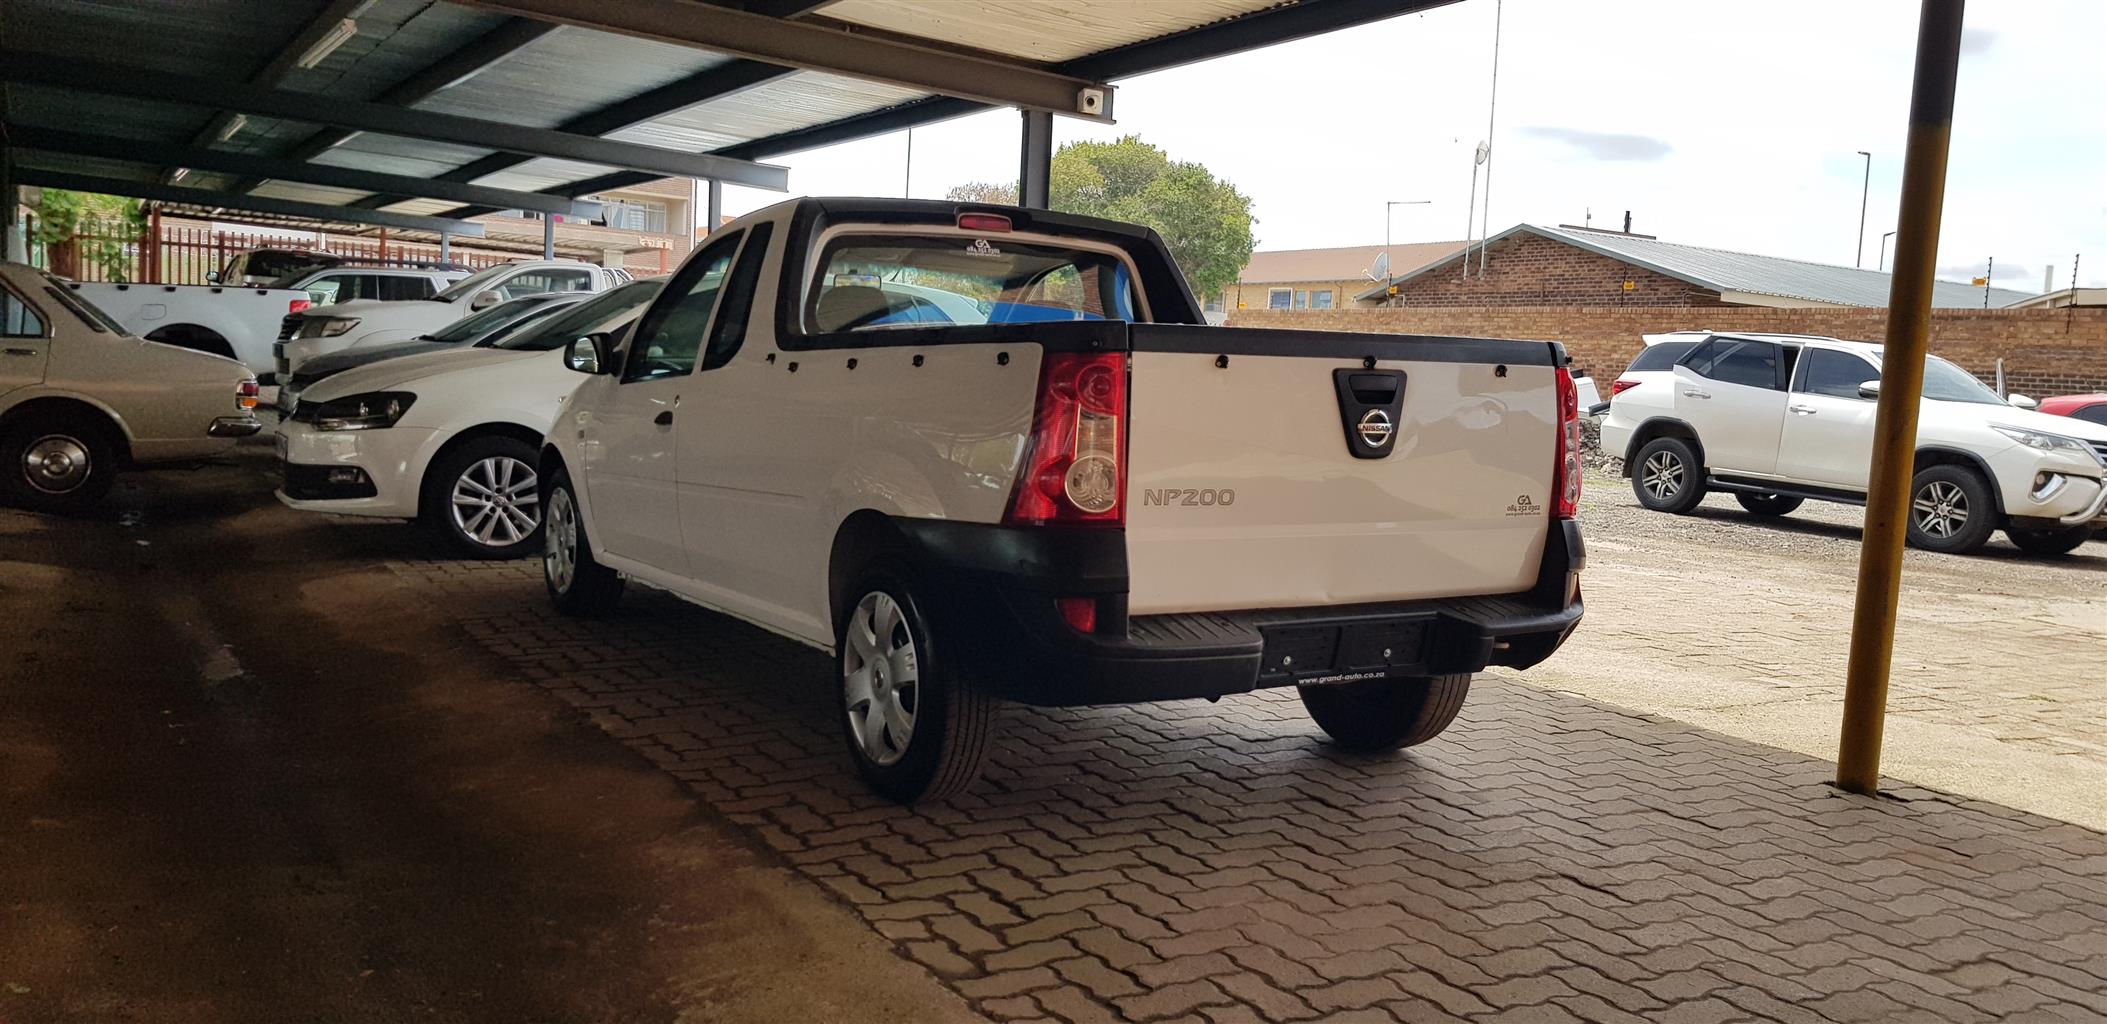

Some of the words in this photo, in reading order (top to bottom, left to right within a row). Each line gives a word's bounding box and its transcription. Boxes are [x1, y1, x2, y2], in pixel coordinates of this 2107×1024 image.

[975, 239, 991, 249] GA
[1362, 425, 1390, 433] NISSAN
[1143, 488, 1235, 506] NP200
[1517, 494, 1532, 505] GA
[1298, 672, 1385, 684] www.grand-auto.co.za
